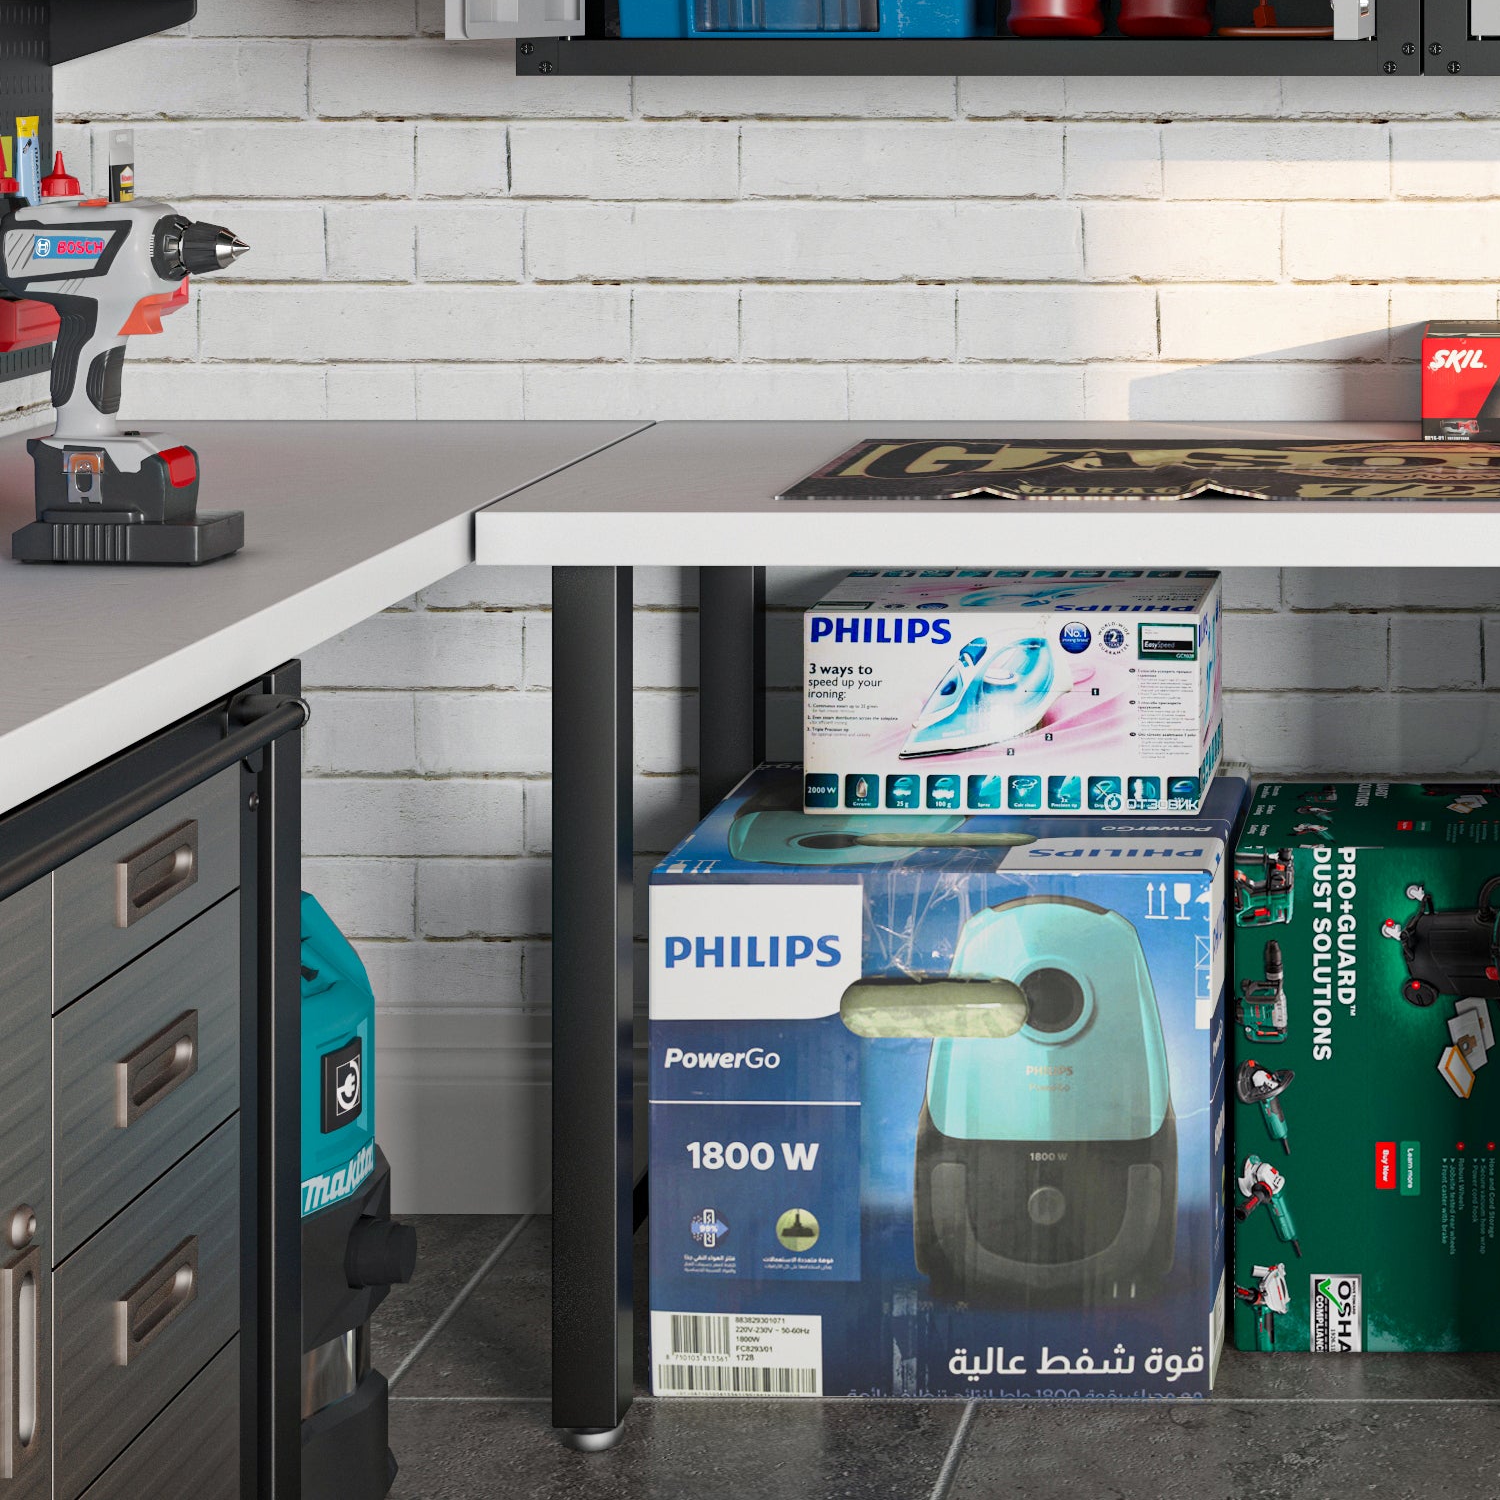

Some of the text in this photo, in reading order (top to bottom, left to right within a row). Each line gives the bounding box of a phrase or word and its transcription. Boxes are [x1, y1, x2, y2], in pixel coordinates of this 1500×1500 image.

[57, 240, 104, 254] BOSCH
[1431, 349, 1484, 373] SKIL
[811, 617, 952, 644] PHILIPS
[1063, 628, 1087, 638] No.1
[808, 663, 873, 677] 3 ways to
[807, 689, 847, 701] ironing:
[808, 677, 883, 689] speed up your
[807, 786, 837, 794] 2000 W
[1101, 825, 1213, 833] PowerGo
[1029, 847, 1205, 859] PHILIPS
[664, 934, 842, 968] PHILIPS
[1312, 847, 1332, 1061] DUST SOLUTIONS
[664, 1047, 781, 1069] PowerGo
[686, 1141, 820, 1172] 1800 W
[1029, 1152, 1055, 1162] 1800
[1382, 1148, 1390, 1182] Buy Now
[1406, 1148, 1414, 1189] Learn more
[304, 1138, 375, 1213] makita
[1315, 1295, 1325, 1352] COMPLIANC
[1338, 1281, 1352, 1352] OSHA
[948, 1343, 1205, 1382] قوة شفط عالية
